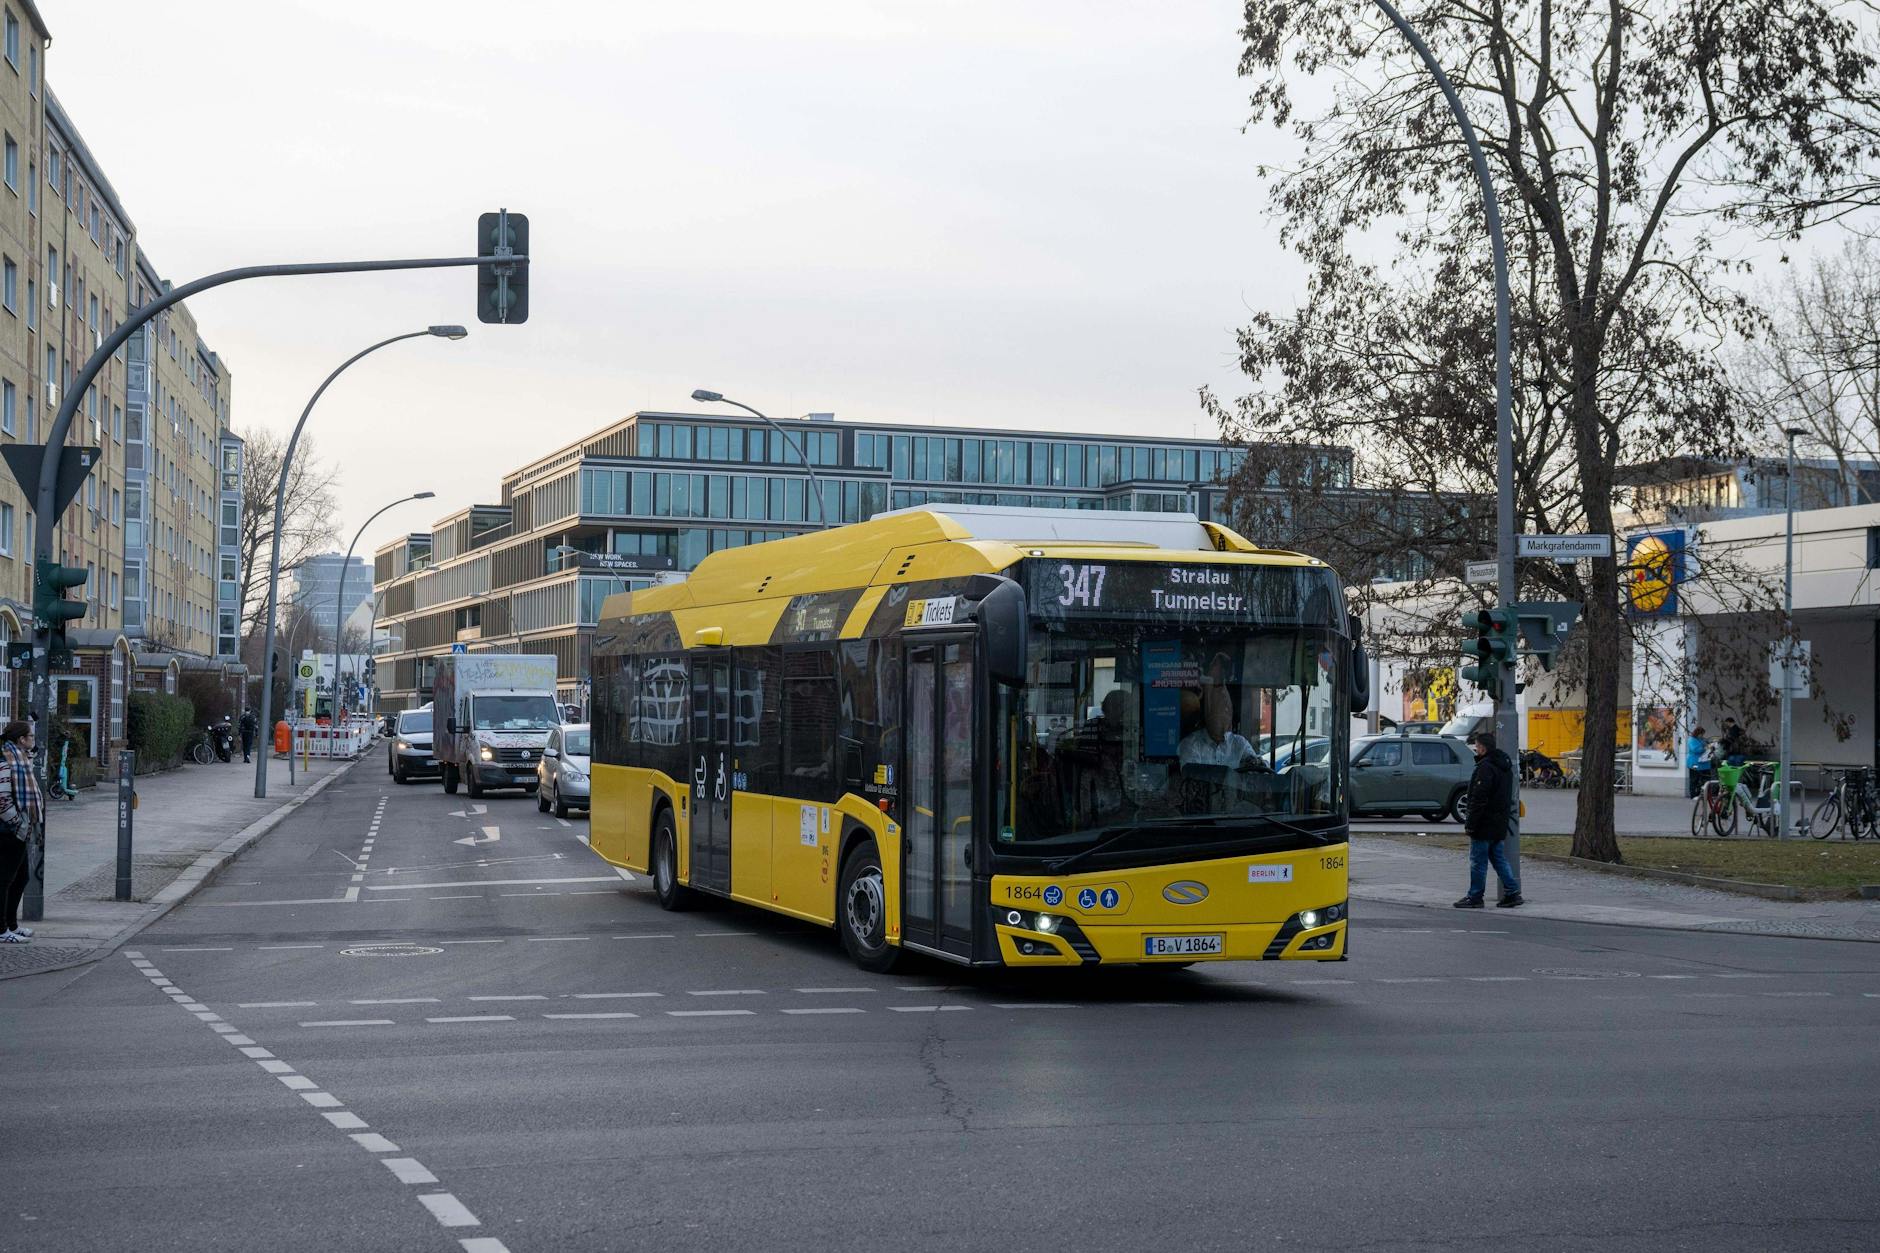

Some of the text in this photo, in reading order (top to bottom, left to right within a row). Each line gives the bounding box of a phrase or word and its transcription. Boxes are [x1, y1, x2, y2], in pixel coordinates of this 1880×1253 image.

[1527, 541, 1601, 552] Markgrafendamm
[1171, 568, 1230, 584] Stralau
[1059, 564, 1106, 607] 347
[1151, 590, 1247, 610] Tunnelstr.
[926, 602, 952, 623] Tickets
[1319, 856, 1344, 869] 1864
[1006, 886, 1042, 899] 1864
[1158, 938, 1216, 952] B V 1864
